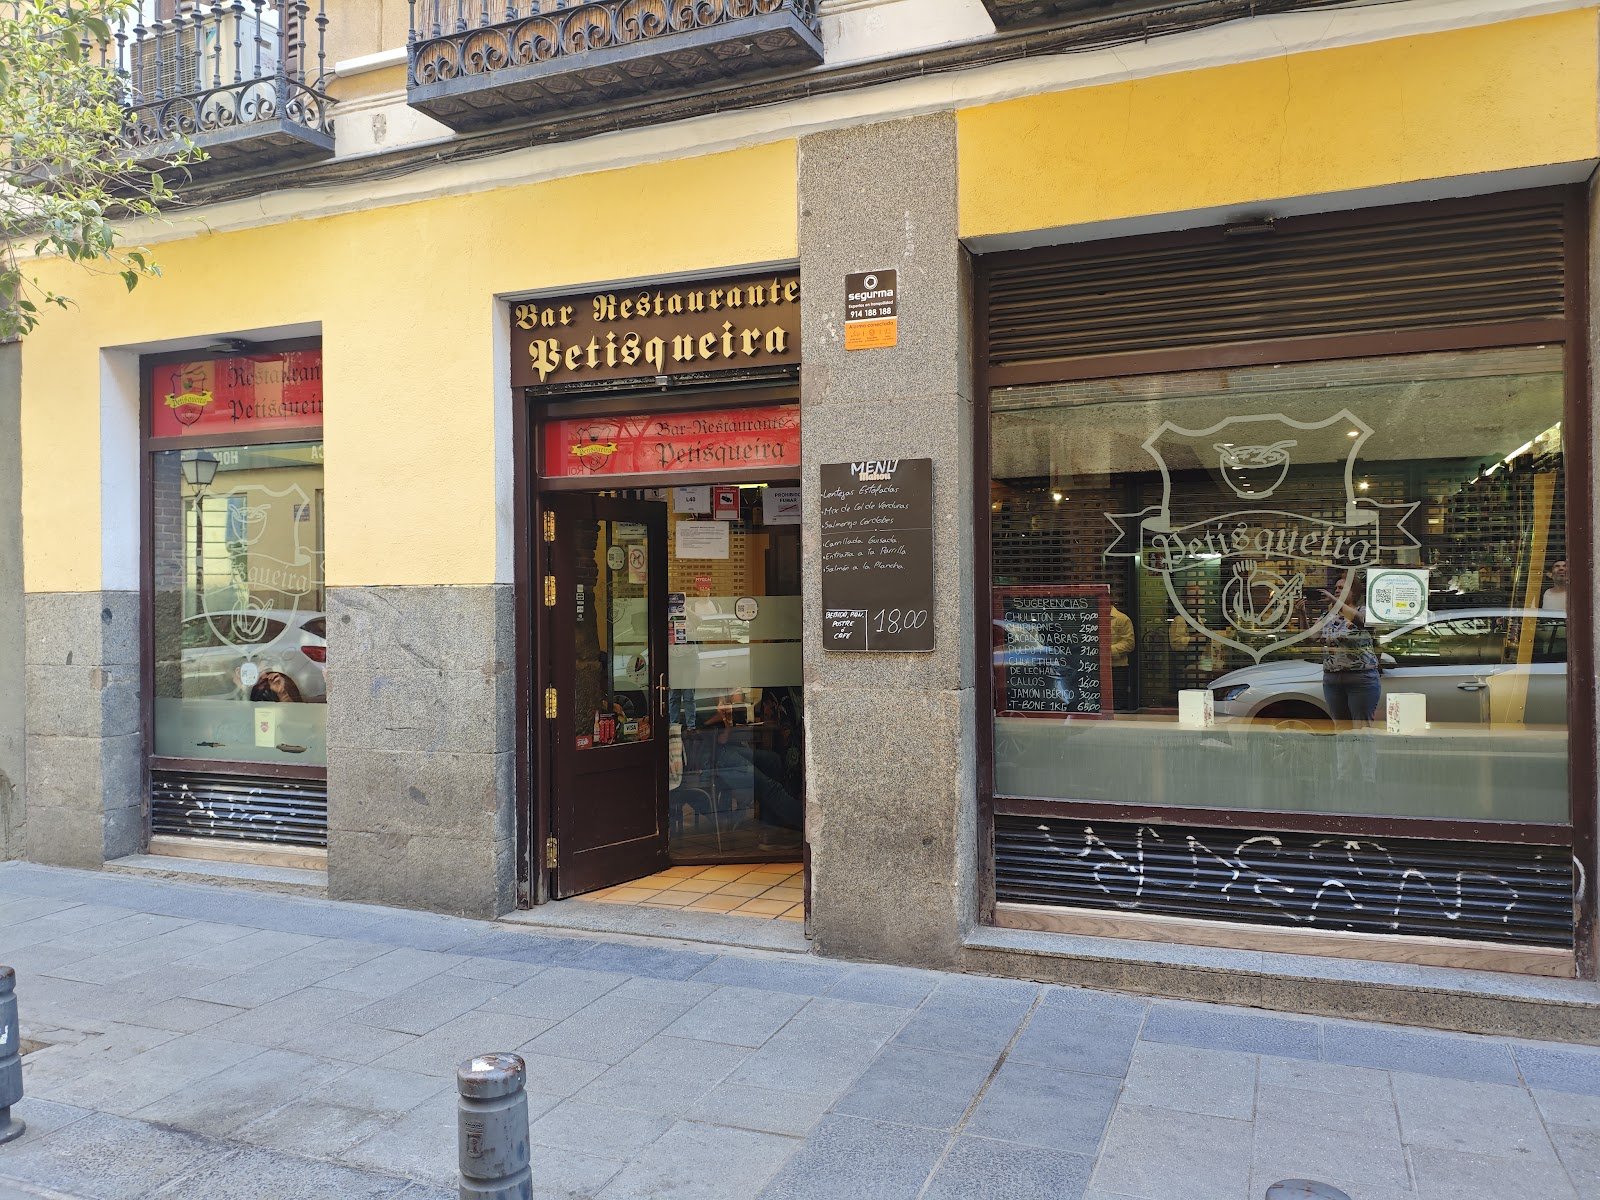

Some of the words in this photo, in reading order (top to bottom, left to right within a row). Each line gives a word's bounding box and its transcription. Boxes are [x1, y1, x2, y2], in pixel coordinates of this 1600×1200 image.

[848, 289, 894, 301] segurma
[515, 303, 575, 330] Bar
[592, 277, 800, 322] Restaurante
[850, 310, 863, 318] 914
[864, 308, 877, 317] 188
[879, 307, 892, 315] 188
[528, 320, 790, 383] Petisqueira
[228, 364, 322, 389] Restauran
[655, 438, 785, 468] Petisqueira
[841, 504, 851, 513] de
[865, 501, 876, 510] de
[1151, 521, 1371, 573] Petisqueira
[863, 562, 870, 570] la
[1013, 598, 1088, 608] SUGERENCIAS
[873, 608, 928, 634] 18,00
[1054, 633, 1079, 644] BRAS
[1010, 667, 1021, 675] DE
[1010, 677, 1045, 686] CALLOS
[1010, 688, 1040, 699] JAMÓN
[1010, 700, 1046, 710] T-BONE
[1049, 701, 1068, 711] 1KG
